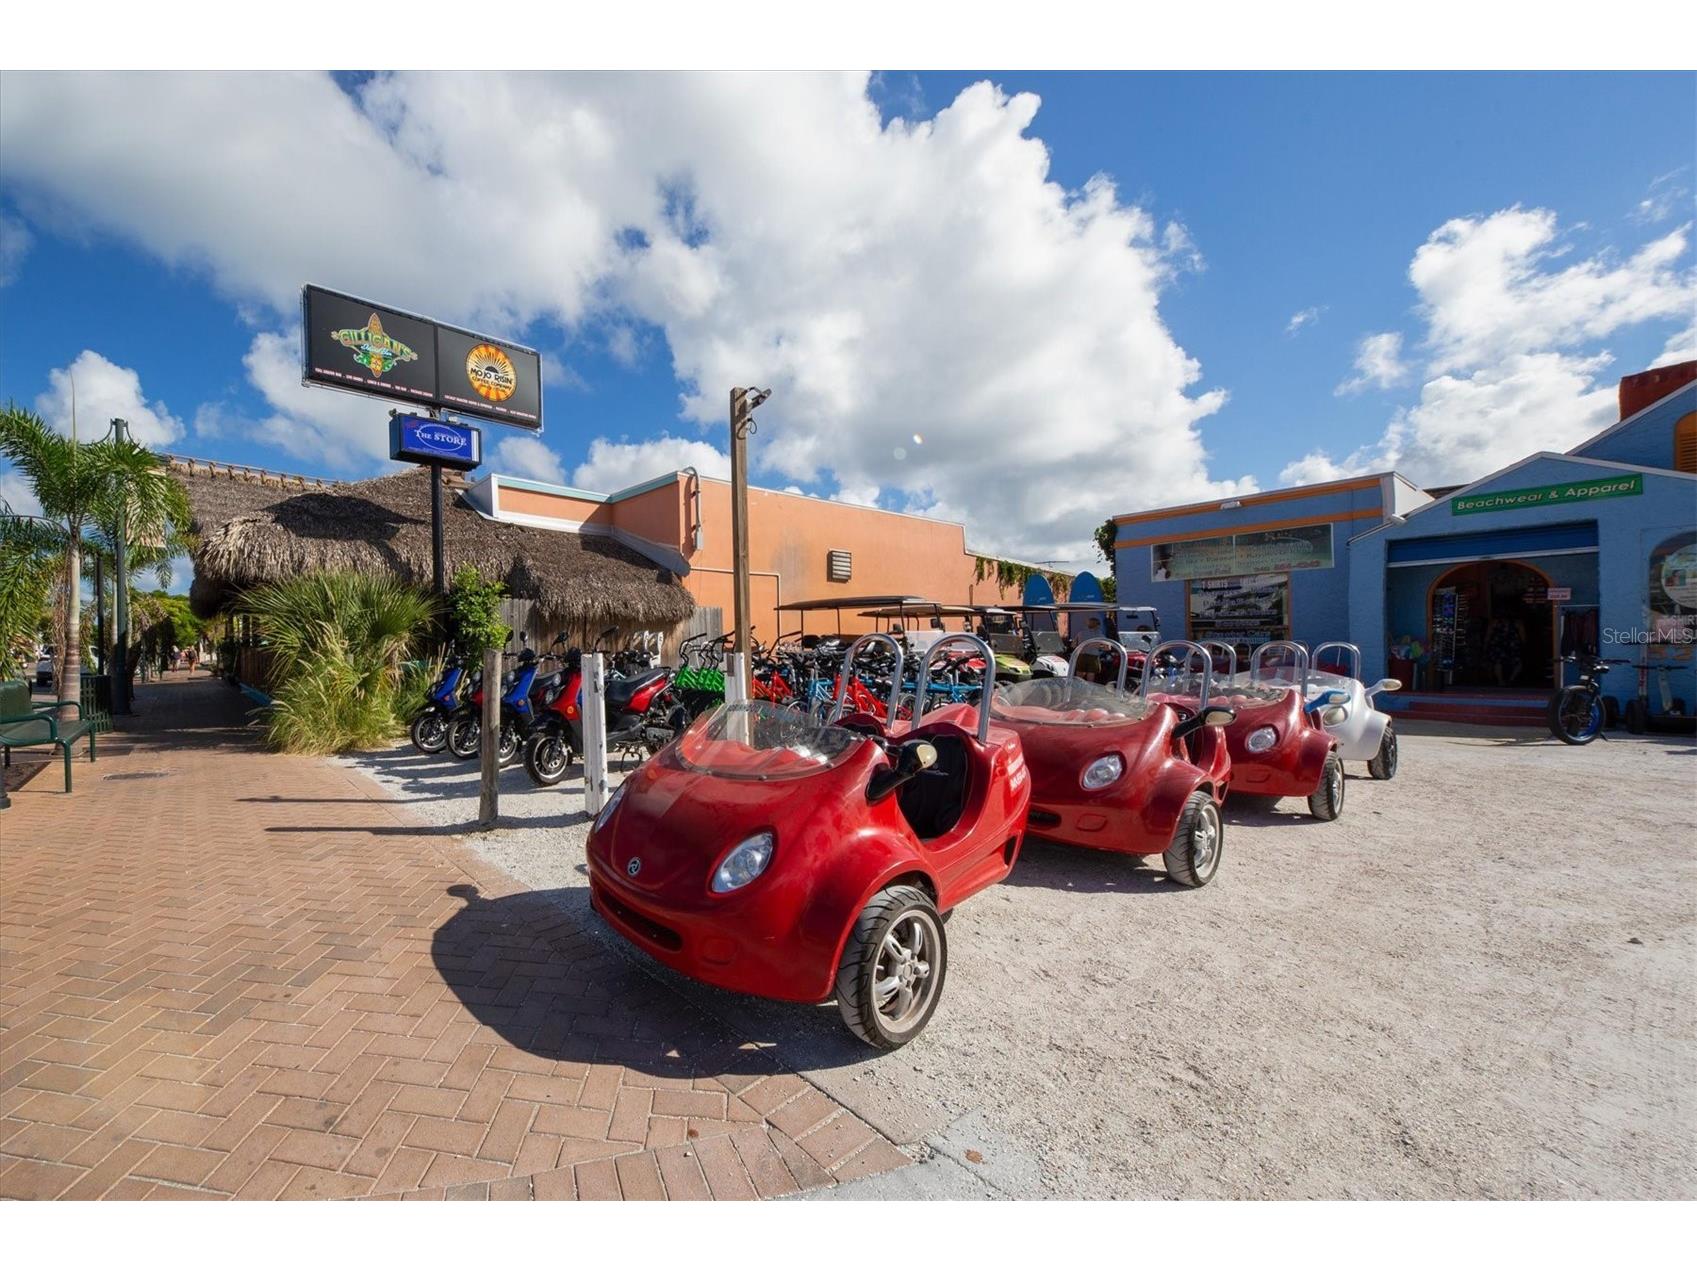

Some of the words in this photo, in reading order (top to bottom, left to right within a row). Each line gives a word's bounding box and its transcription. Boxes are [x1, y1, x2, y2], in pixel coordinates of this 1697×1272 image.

[340, 329, 412, 361] GILLIGAN'S
[470, 368, 492, 379] MOJO
[433, 432, 467, 446] STORE
[1457, 493, 1543, 510] Beachwear
[1548, 490, 1559, 499] &
[1565, 480, 1635, 498] Apparel
